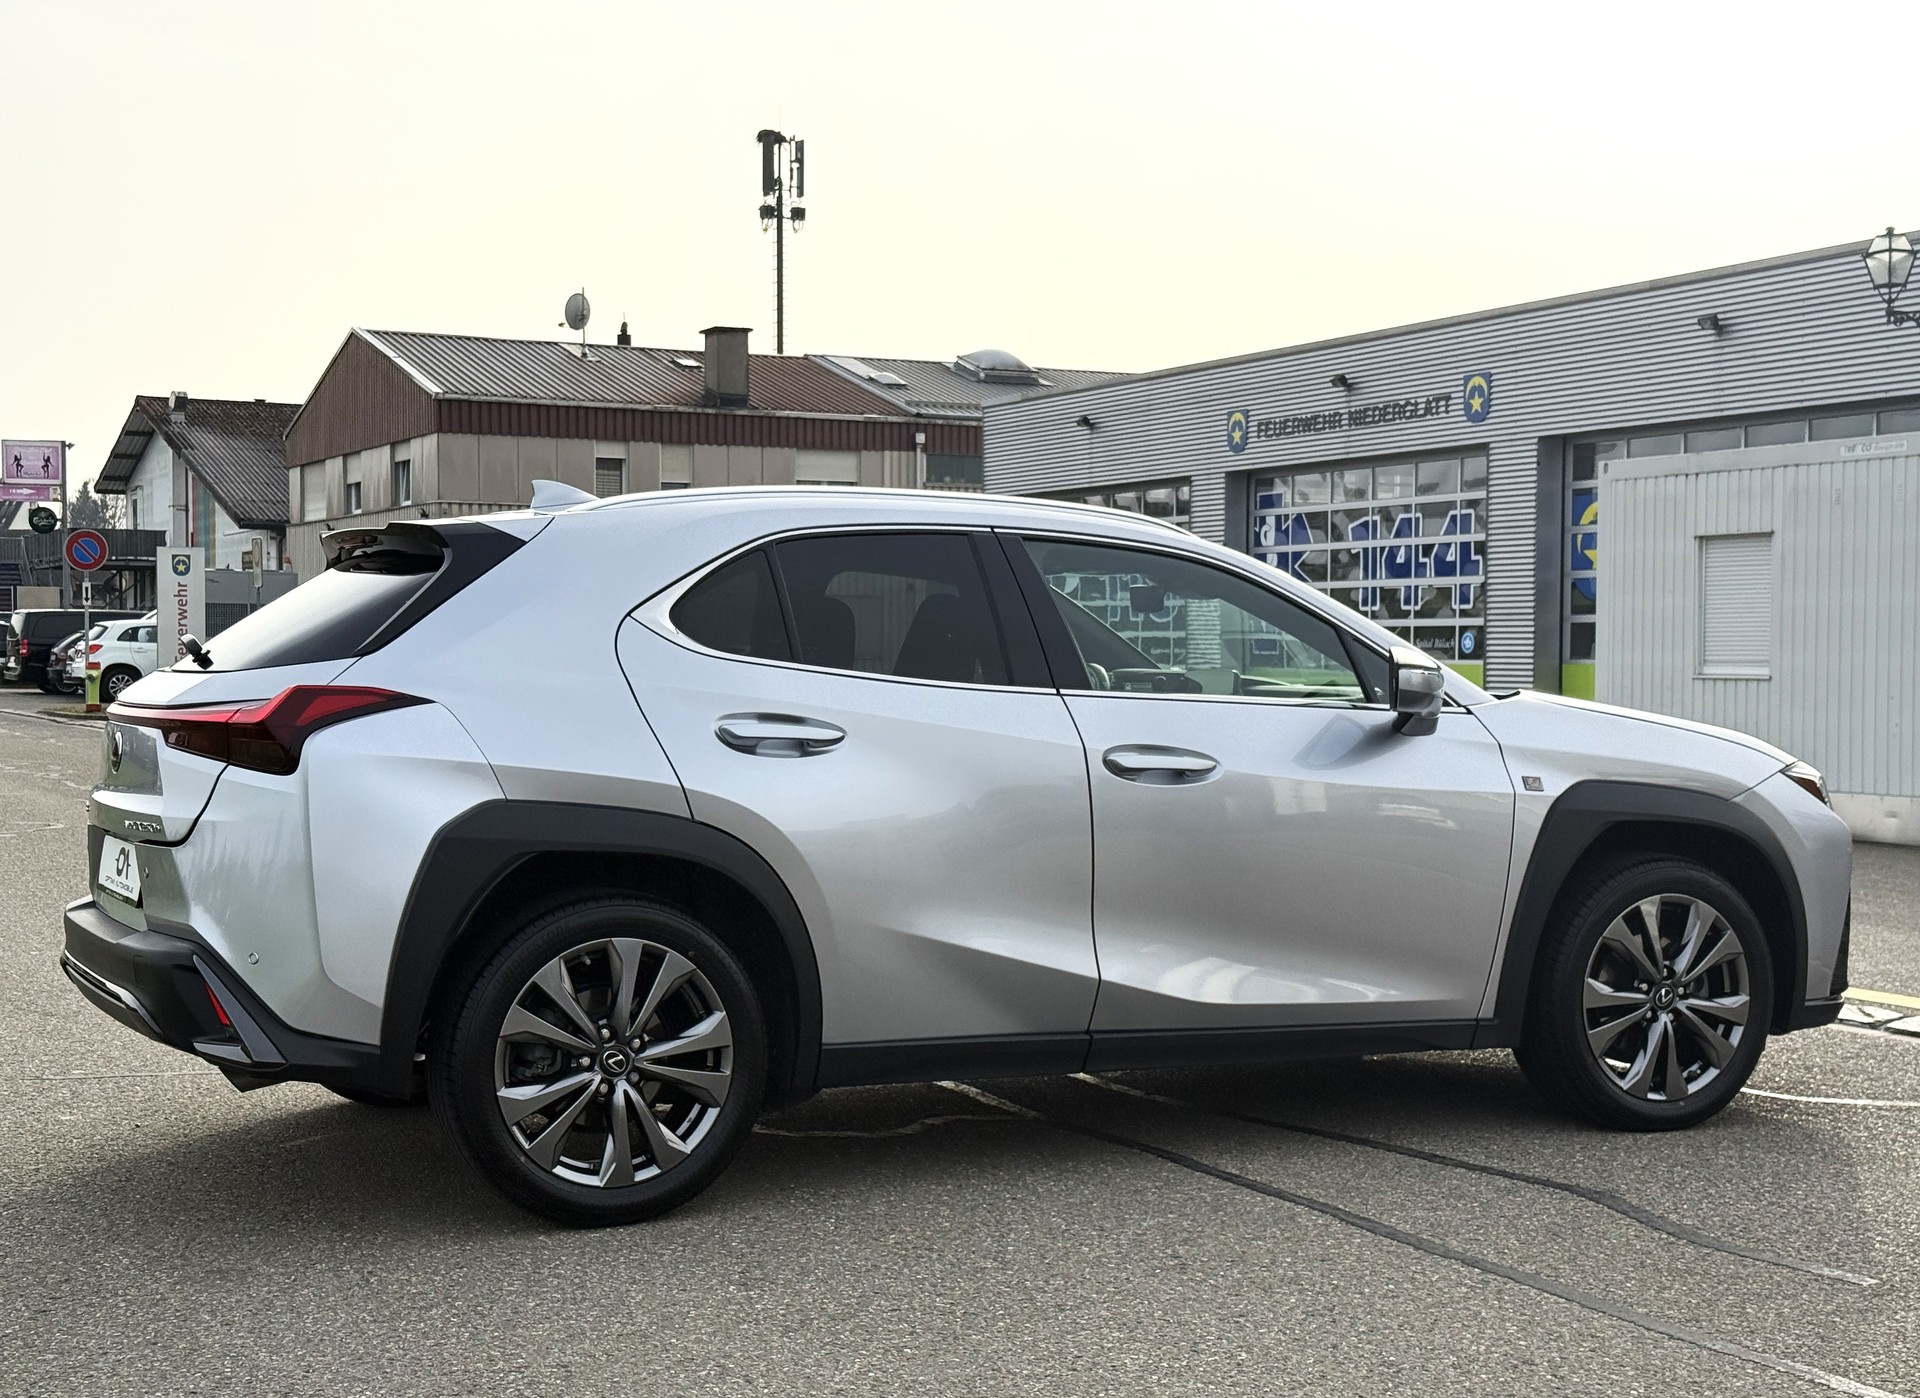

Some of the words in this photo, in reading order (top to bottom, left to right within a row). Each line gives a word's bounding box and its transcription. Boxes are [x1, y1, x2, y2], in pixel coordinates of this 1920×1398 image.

[1256, 411, 1344, 440] FEUERWEHR
[1348, 394, 1452, 429] NIEDERGLATT
[1348, 508, 1483, 611] 144
